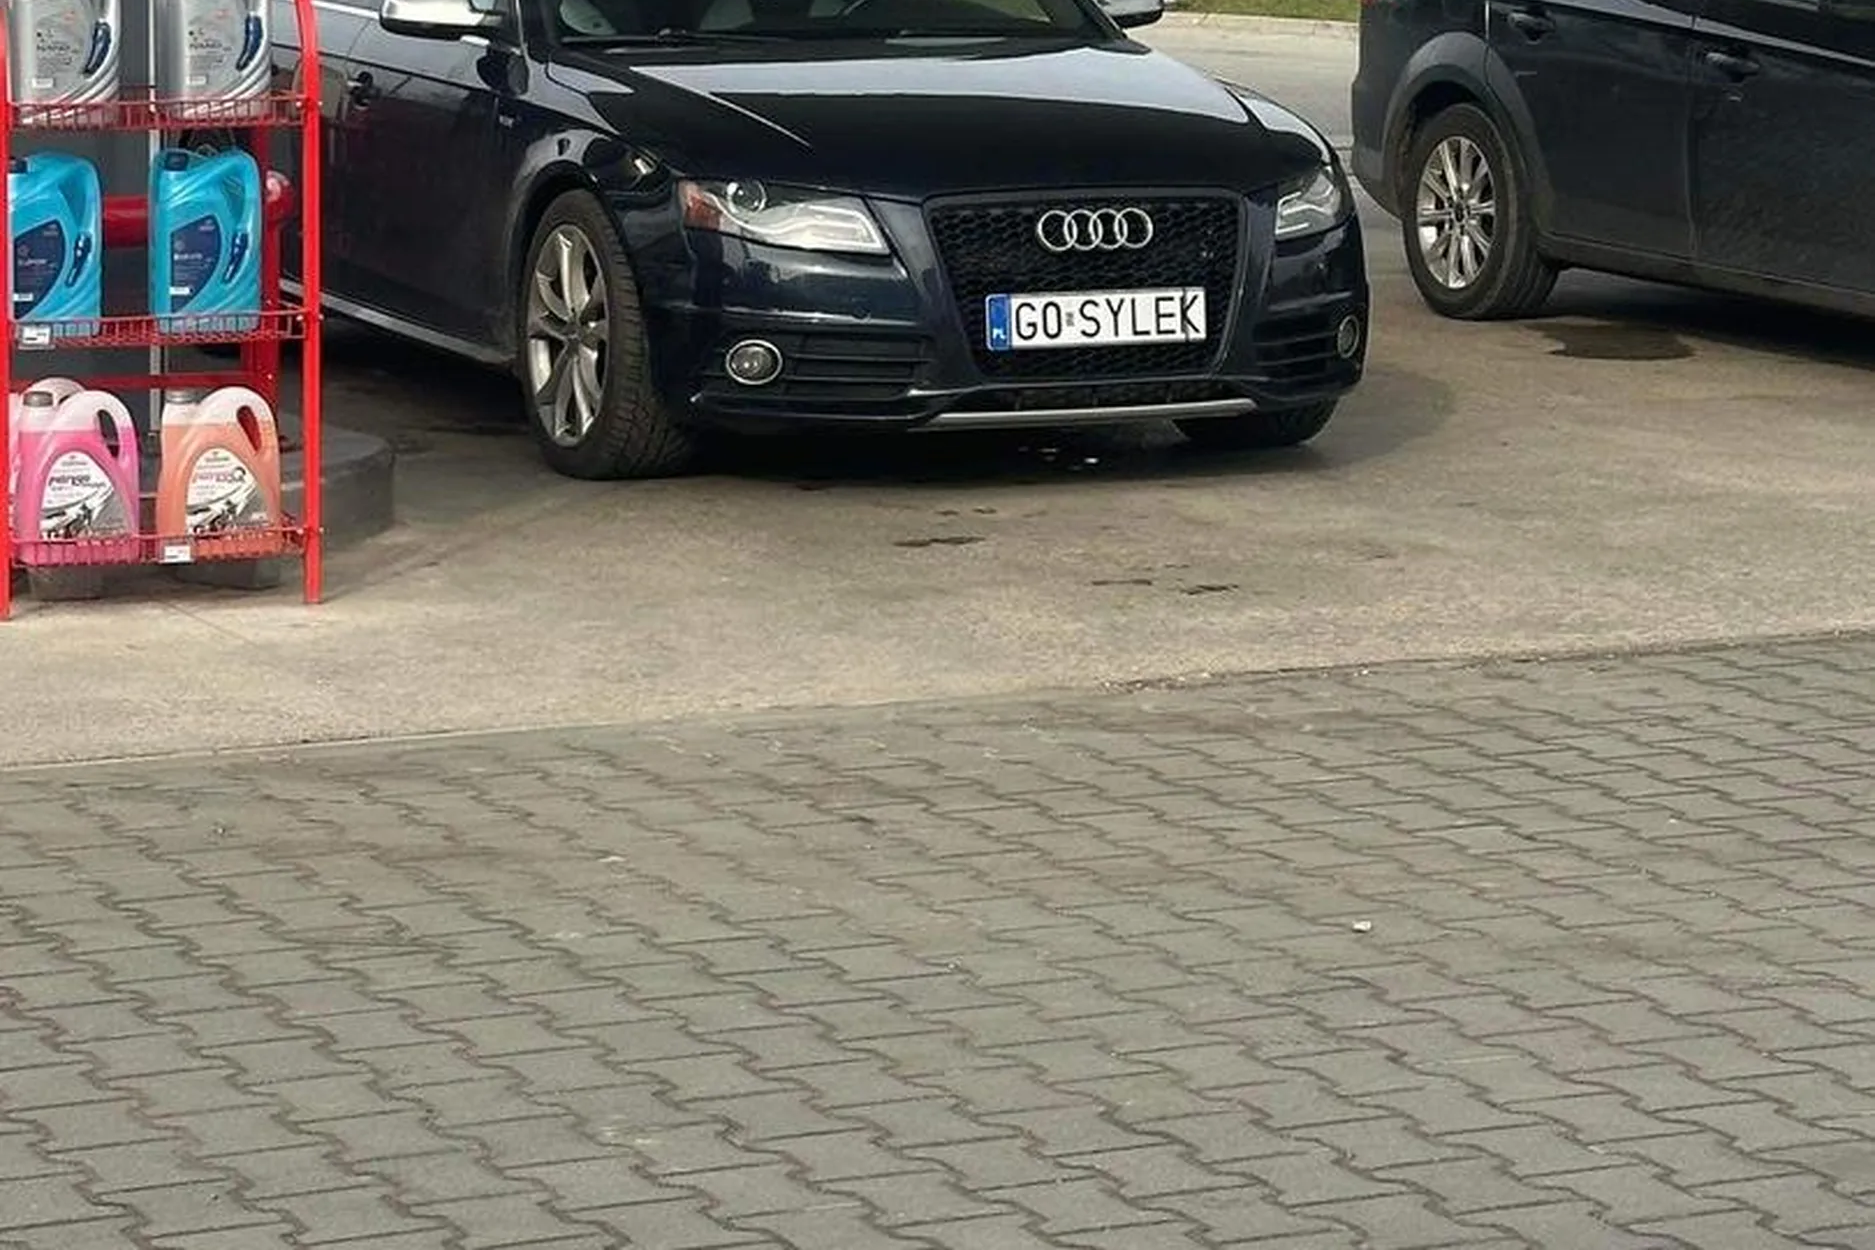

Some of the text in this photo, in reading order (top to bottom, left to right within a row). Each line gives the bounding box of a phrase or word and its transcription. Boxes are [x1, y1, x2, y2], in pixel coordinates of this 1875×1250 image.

[1014, 294, 1201, 340] GO SYLEK
[992, 328, 1006, 340] PL
